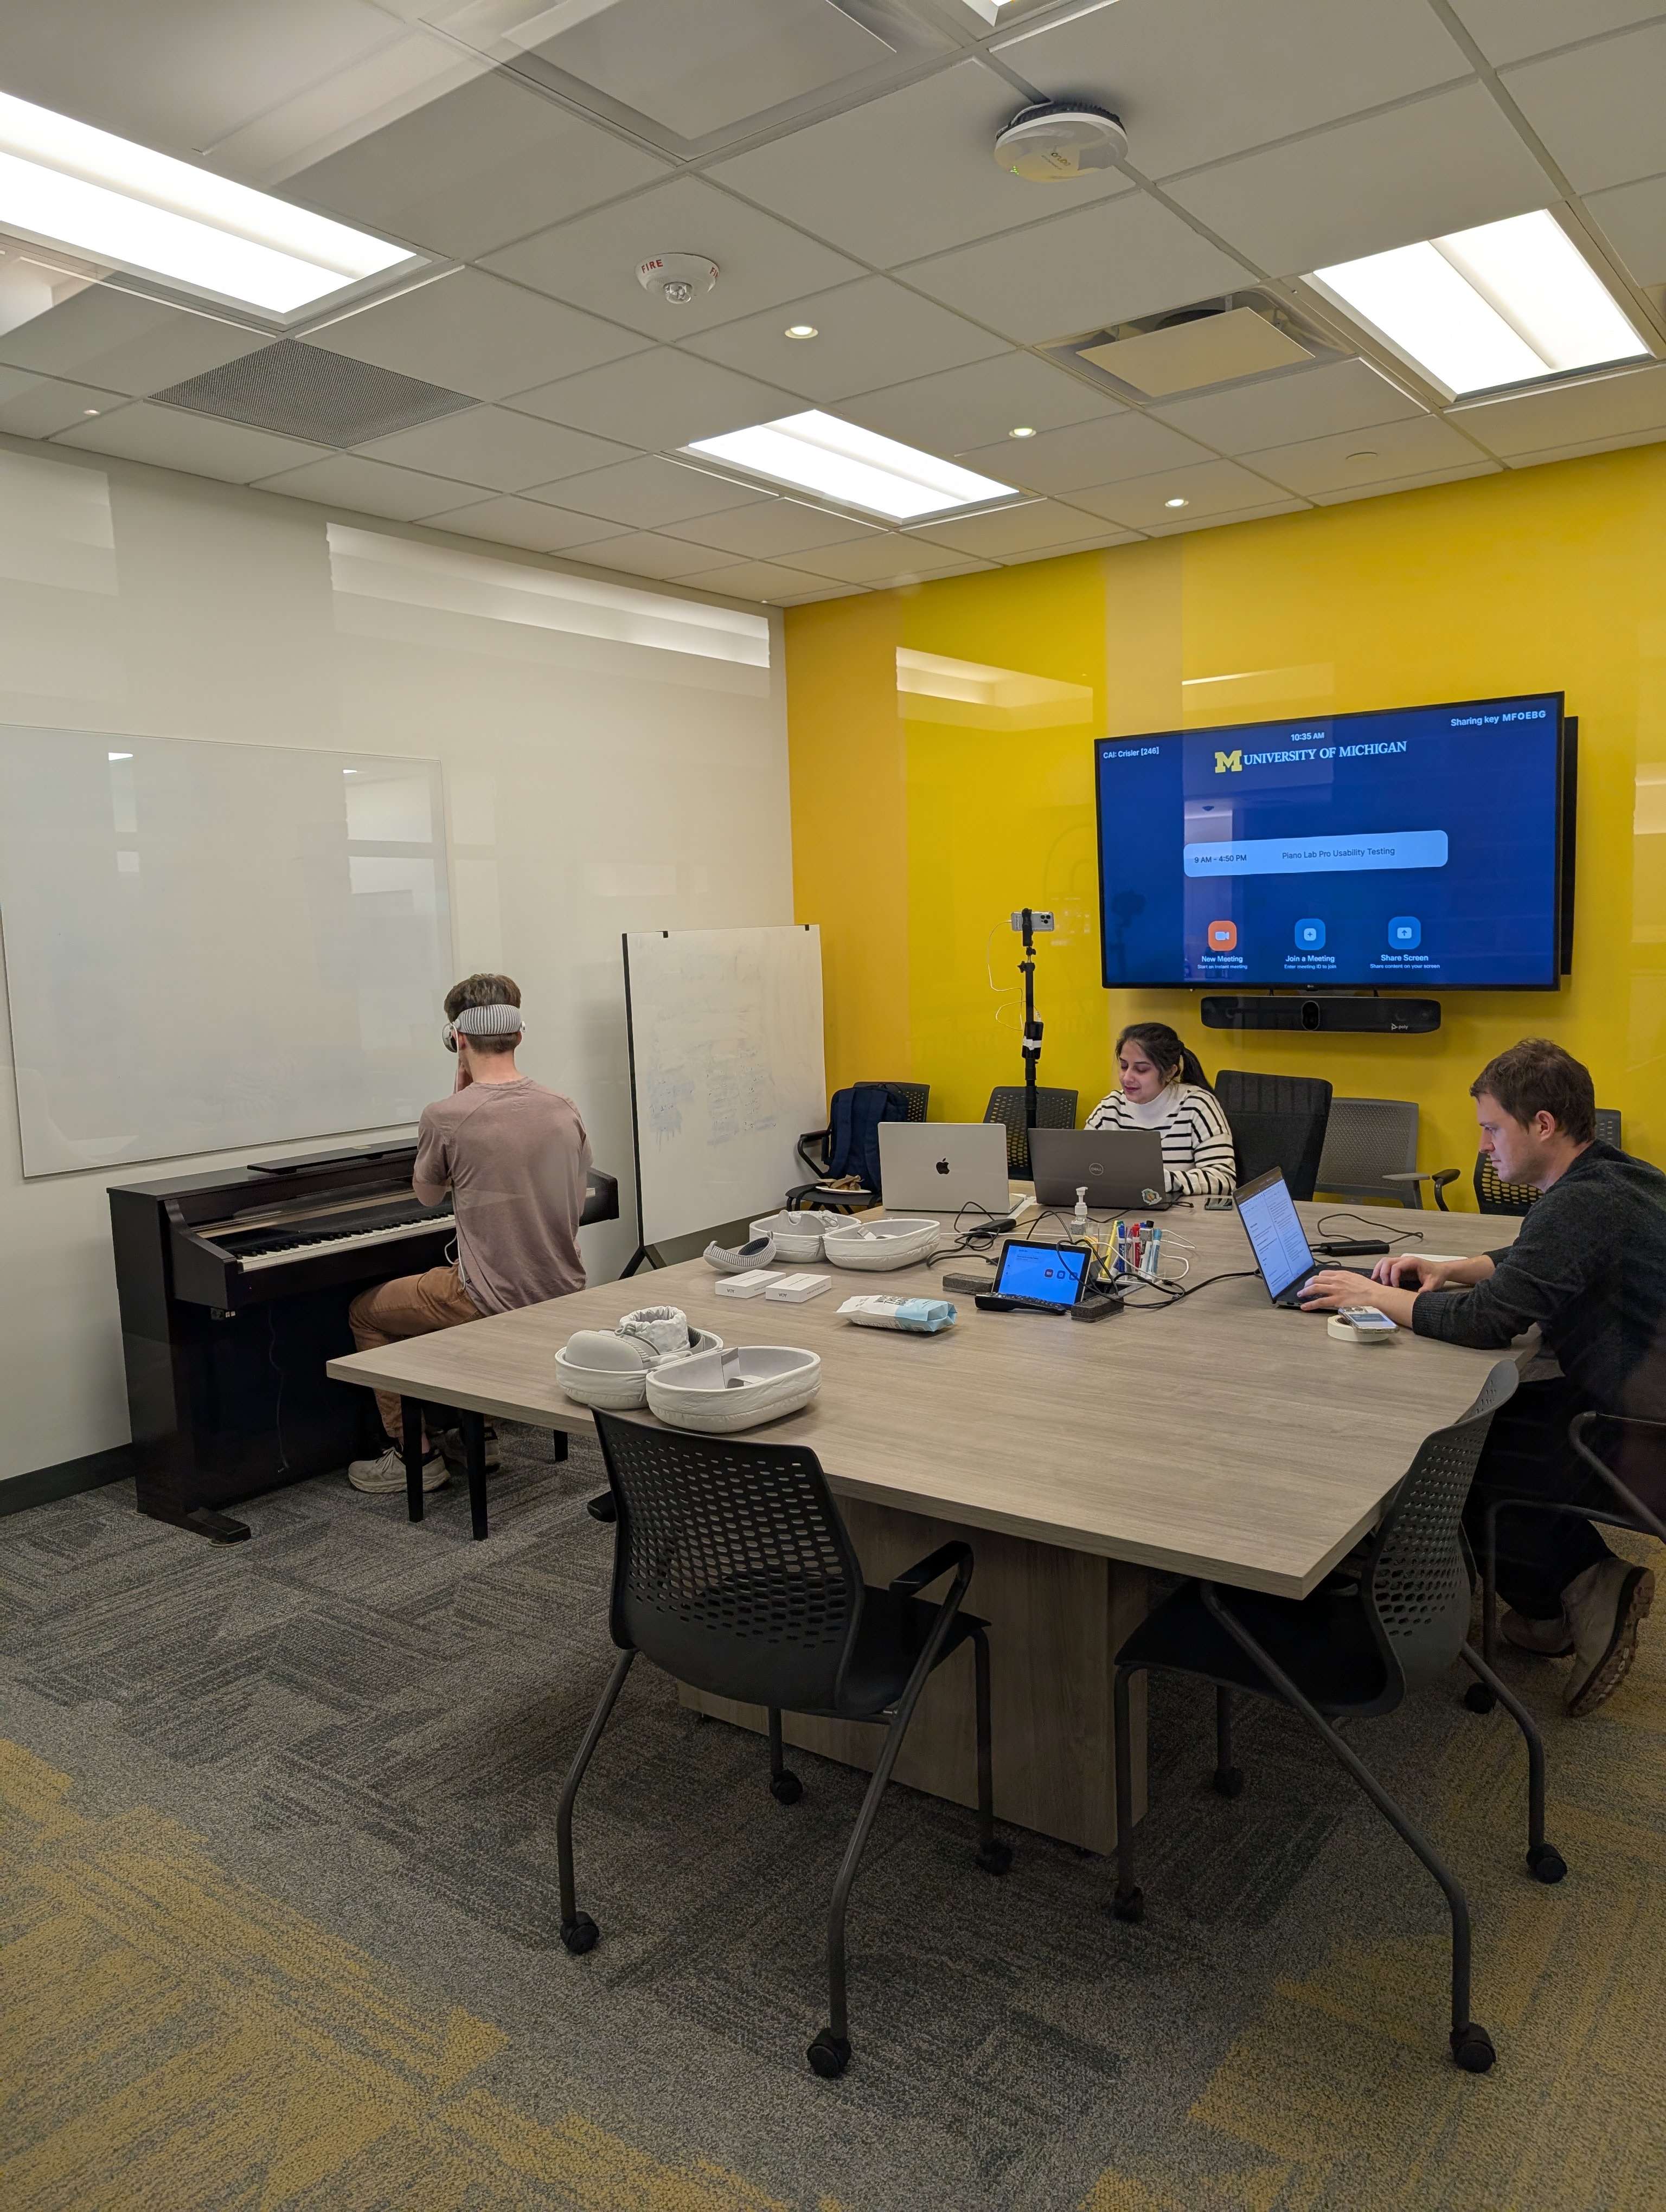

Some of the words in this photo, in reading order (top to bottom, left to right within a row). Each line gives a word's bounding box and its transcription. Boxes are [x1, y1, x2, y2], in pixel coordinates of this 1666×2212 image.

[641, 259, 663, 274] FIRE
[1451, 717, 1482, 726] Sharing
[1484, 716, 1500, 724] key
[1291, 732, 1312, 741] 10:35
[1140, 747, 1159, 756] [246]
[1214, 750, 1242, 773] M
[1244, 749, 1317, 765] UNIVERSITY
[1319, 747, 1336, 759] OF
[1338, 741, 1407, 757] MICHIGAN
[1332, 848, 1365, 857] Usability
[1367, 847, 1395, 856] Testing
[1217, 955, 1243, 963] Meeting
[1308, 955, 1335, 963] Meeting
